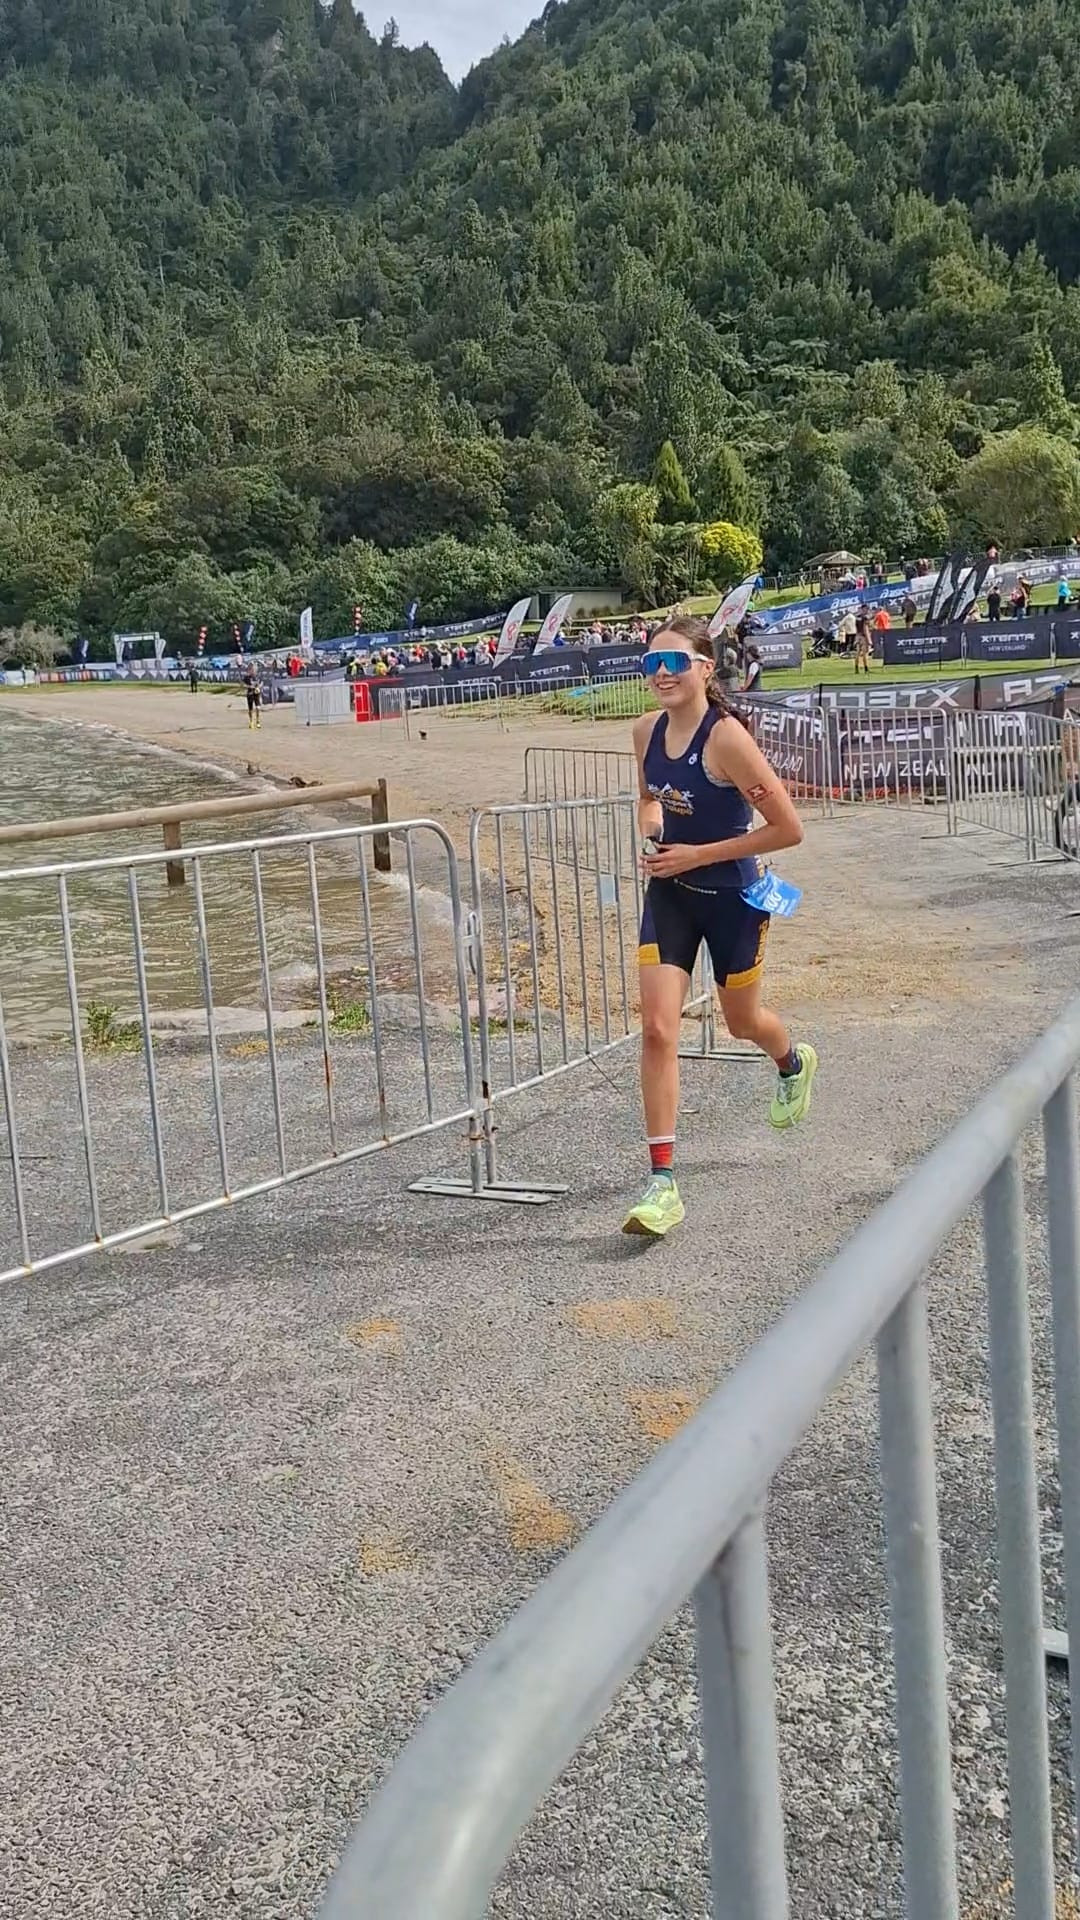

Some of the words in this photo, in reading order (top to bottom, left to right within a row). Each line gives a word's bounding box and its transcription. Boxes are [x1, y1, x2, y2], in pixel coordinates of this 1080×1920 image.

[782, 615, 817, 630] TERRA
[896, 636, 948, 647] XTERRA
[981, 633, 1036, 643] XTERRA
[597, 655, 641, 667] XTERRA
[529, 664, 571, 678] XTERRA
[844, 762, 892, 781] NEW
[898, 760, 995, 778] ZEALND
